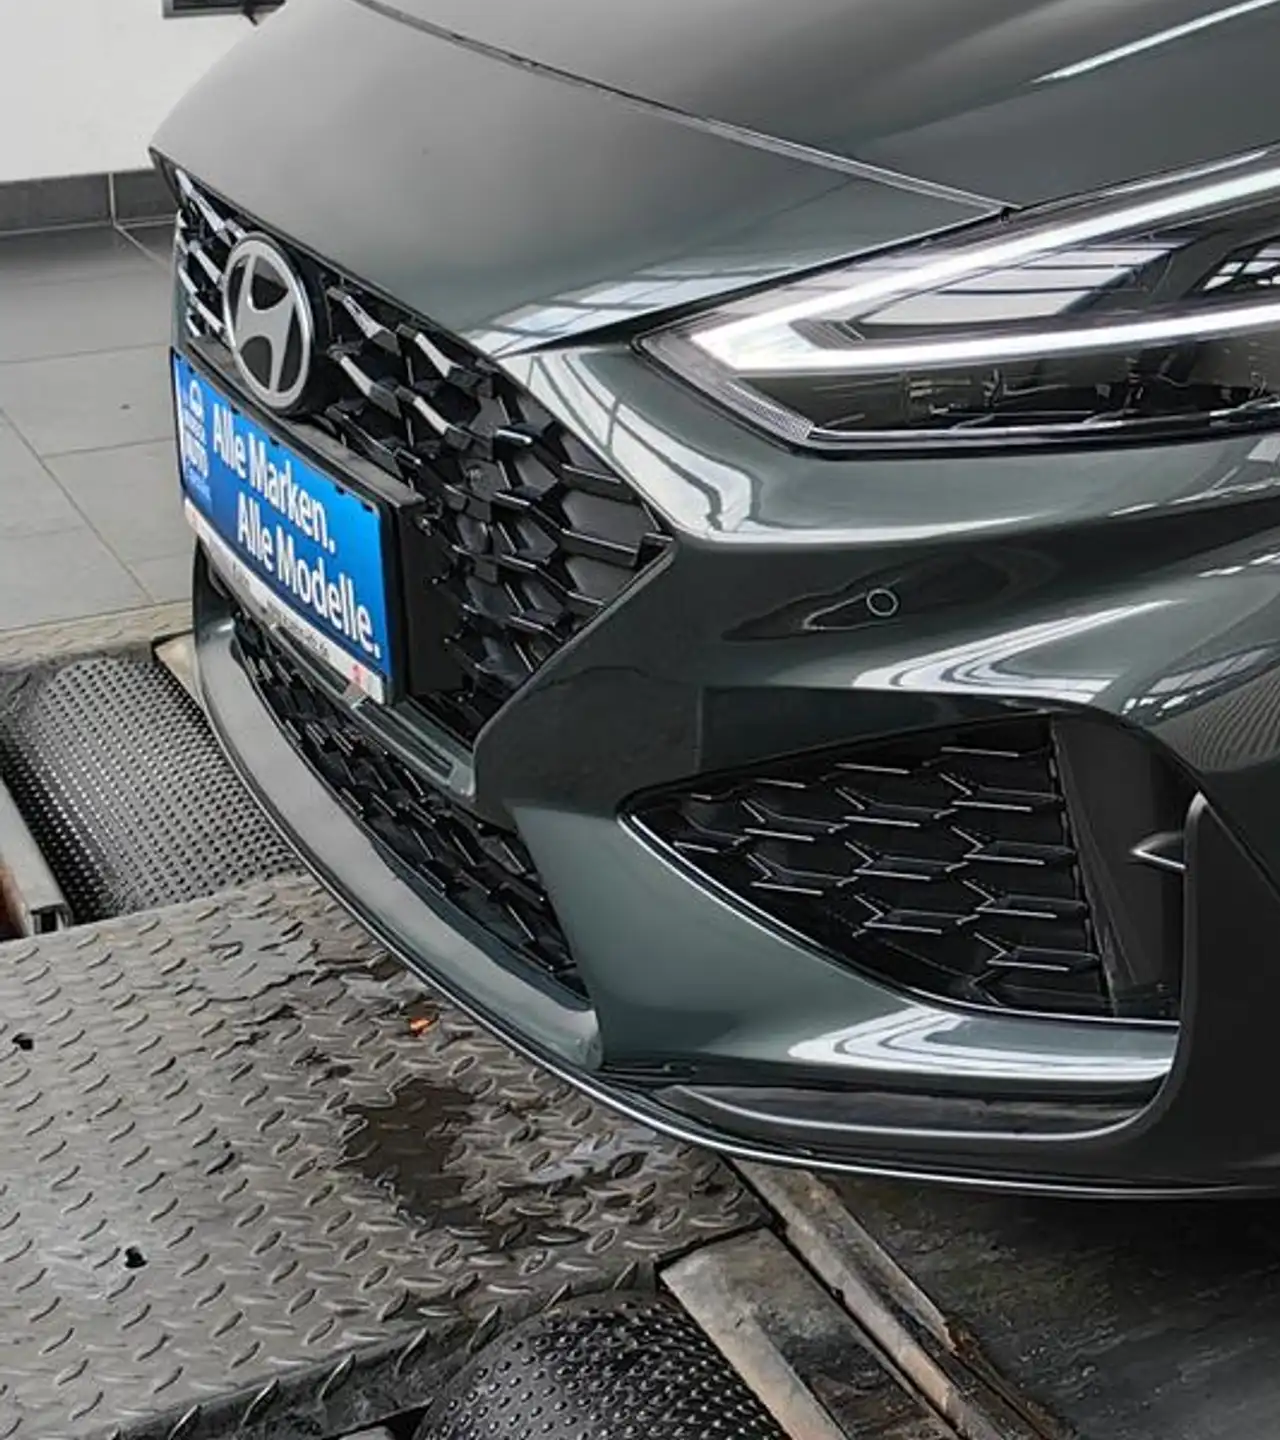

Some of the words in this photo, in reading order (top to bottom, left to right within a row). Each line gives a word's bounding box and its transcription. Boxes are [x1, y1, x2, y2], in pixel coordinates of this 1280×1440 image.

[212, 402, 247, 480] Alle
[249, 431, 336, 555] Marken.
[237, 491, 275, 573] Alle
[276, 525, 381, 659] Modelle.
